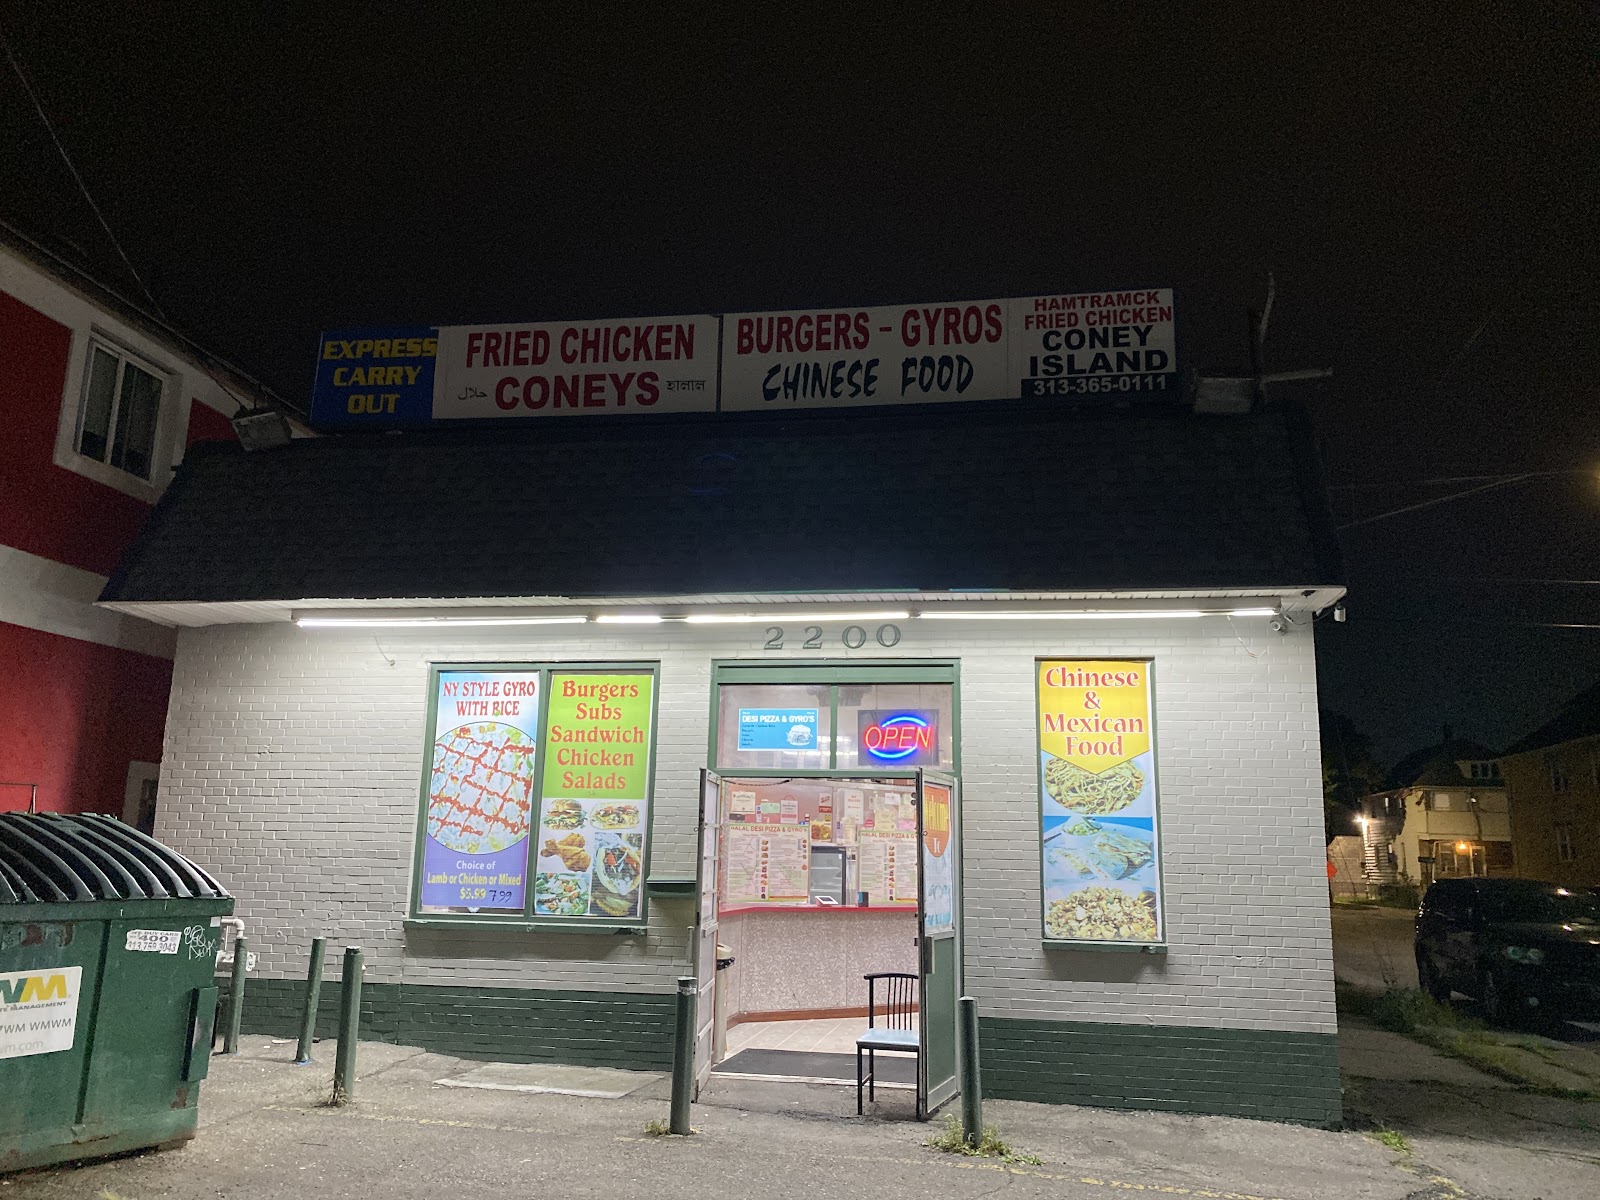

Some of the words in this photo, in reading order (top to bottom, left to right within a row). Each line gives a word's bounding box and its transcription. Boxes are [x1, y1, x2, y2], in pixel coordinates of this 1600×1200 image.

[1034, 290, 1160, 311] HAMTRAMCK
[1024, 312, 1079, 331] FRIED
[1085, 306, 1172, 326] CHICKEN
[736, 312, 870, 355] BURGERS
[901, 304, 1002, 347] GYROS
[1042, 325, 1153, 351] CONEY
[323, 337, 438, 360] EXPRESS
[466, 330, 550, 367] FRIED
[560, 324, 695, 364] CHICKEN
[1029, 350, 1168, 377] ISLAND
[333, 366, 422, 387] CARRY
[762, 358, 880, 402] CHINESE
[901, 354, 973, 397] FOOD
[1033, 374, 1166, 396] 313-365-0111
[458, 387, 488, 401] حلال
[495, 371, 660, 411] CONEYS
[347, 393, 400, 414] OUT
[763, 623, 901, 650] 2200
[1045, 667, 1139, 687] Chinese
[443, 681, 460, 697] NY
[462, 681, 500, 697] STYLE
[503, 681, 535, 697] GYRO
[562, 679, 639, 702] Burgers
[456, 700, 489, 716] WITH
[492, 700, 520, 716] RICE
[1084, 691, 1101, 710] &
[575, 702, 622, 720] Subs
[742, 715, 759, 723] DESI
[760, 715, 780, 723] PIZZA
[781, 715, 788, 723] &
[788, 715, 815, 723] GYRO'S
[1043, 713, 1144, 733] Mexican
[550, 725, 644, 743] Sandwich
[864, 725, 933, 750] OPEN
[1066, 735, 1123, 756] Food
[557, 748, 634, 766] Chicken
[561, 771, 626, 789] Salads
[765, 825, 780, 833] PIZZA
[456, 860, 485, 870] Choice
[486, 860, 497, 870] of
[427, 872, 448, 884] Lamb
[449, 876, 458, 884] or
[459, 872, 487, 885] Chicken
[489, 876, 498, 885] or
[498, 873, 522, 886] Mixed
[10, 1001, 67, 1011] MANAGEMENT
[30, 1018, 72, 1032] WMWM
